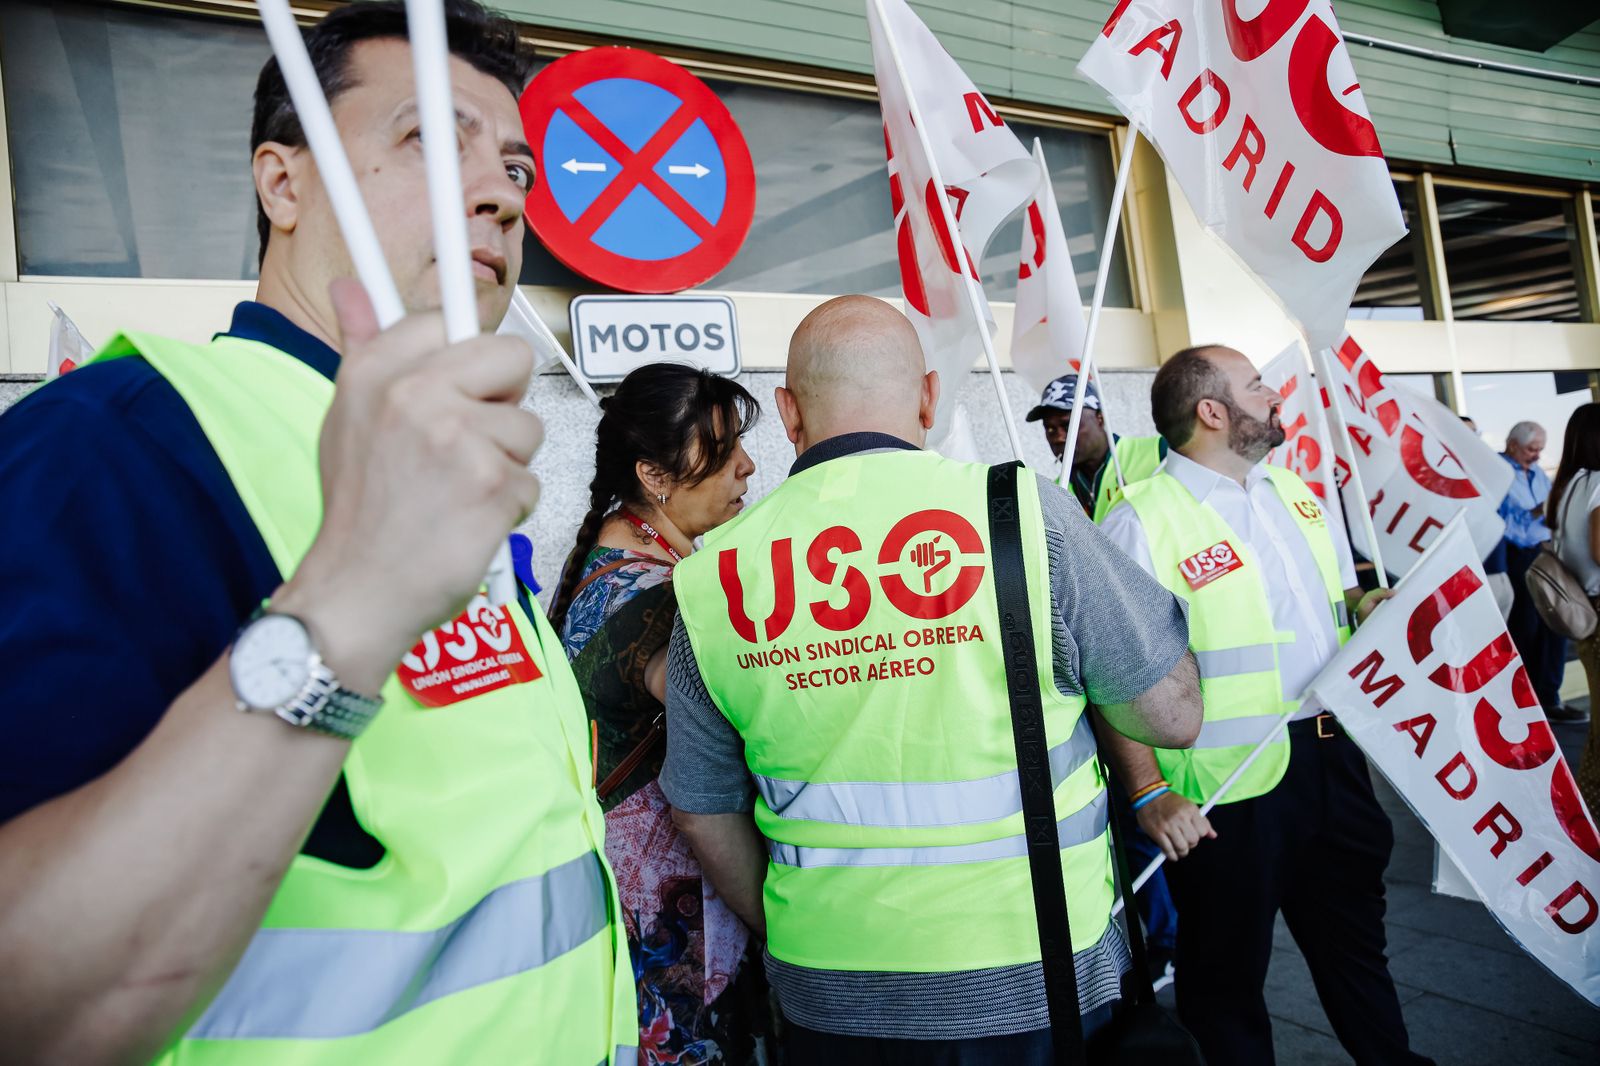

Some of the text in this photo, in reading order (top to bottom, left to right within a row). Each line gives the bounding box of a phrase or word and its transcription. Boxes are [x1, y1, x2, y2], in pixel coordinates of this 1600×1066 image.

[588, 323, 725, 353] MOTOS
[719, 509, 985, 644] USO
[1180, 543, 1233, 579] USO
[737, 624, 985, 669] UNIÓN SINDICAL OBRERA
[785, 656, 936, 691] SECTOR AÉREO
[1348, 649, 1599, 935] MADRID
